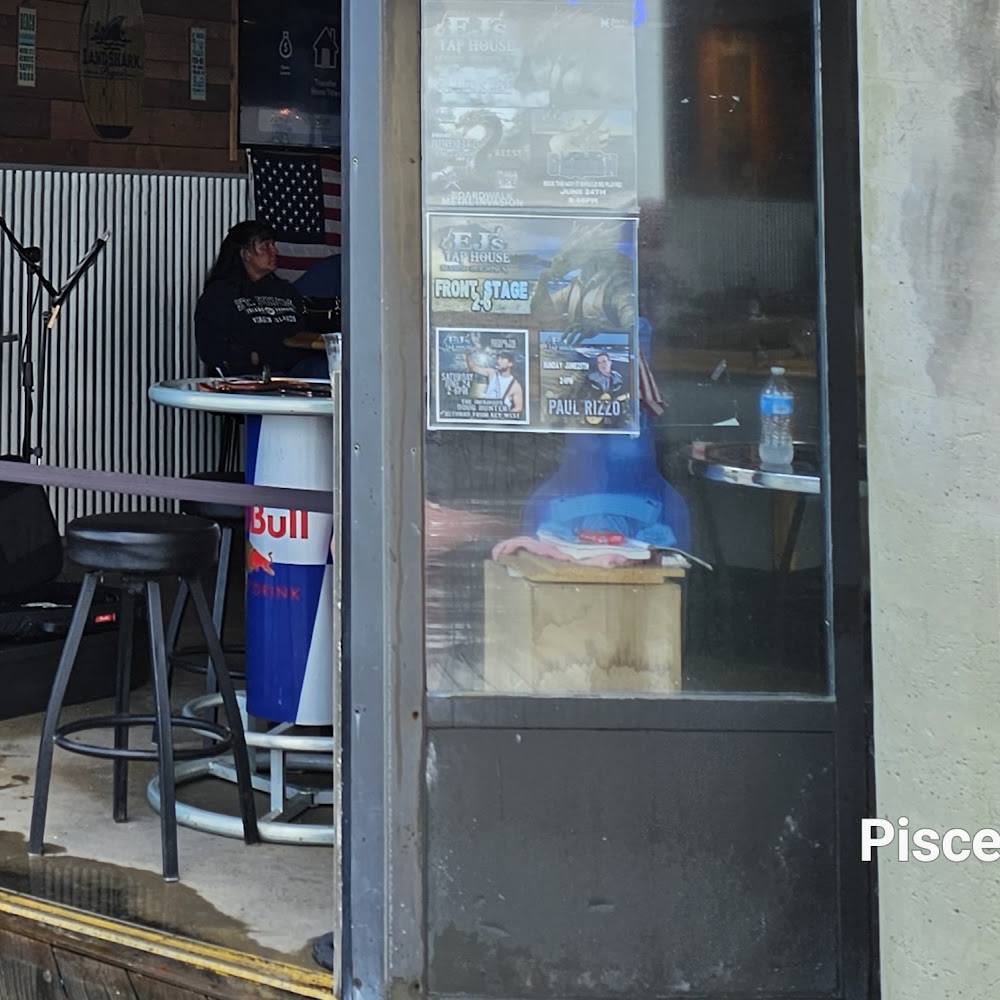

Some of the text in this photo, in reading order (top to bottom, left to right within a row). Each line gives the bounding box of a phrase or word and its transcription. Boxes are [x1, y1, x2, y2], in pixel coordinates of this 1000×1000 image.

[470, 251, 511, 264] HOUSE
[434, 279, 529, 300] FRONT STAGE
[549, 399, 621, 416] PAUL RIZZO
[251, 506, 309, 540] Bull
